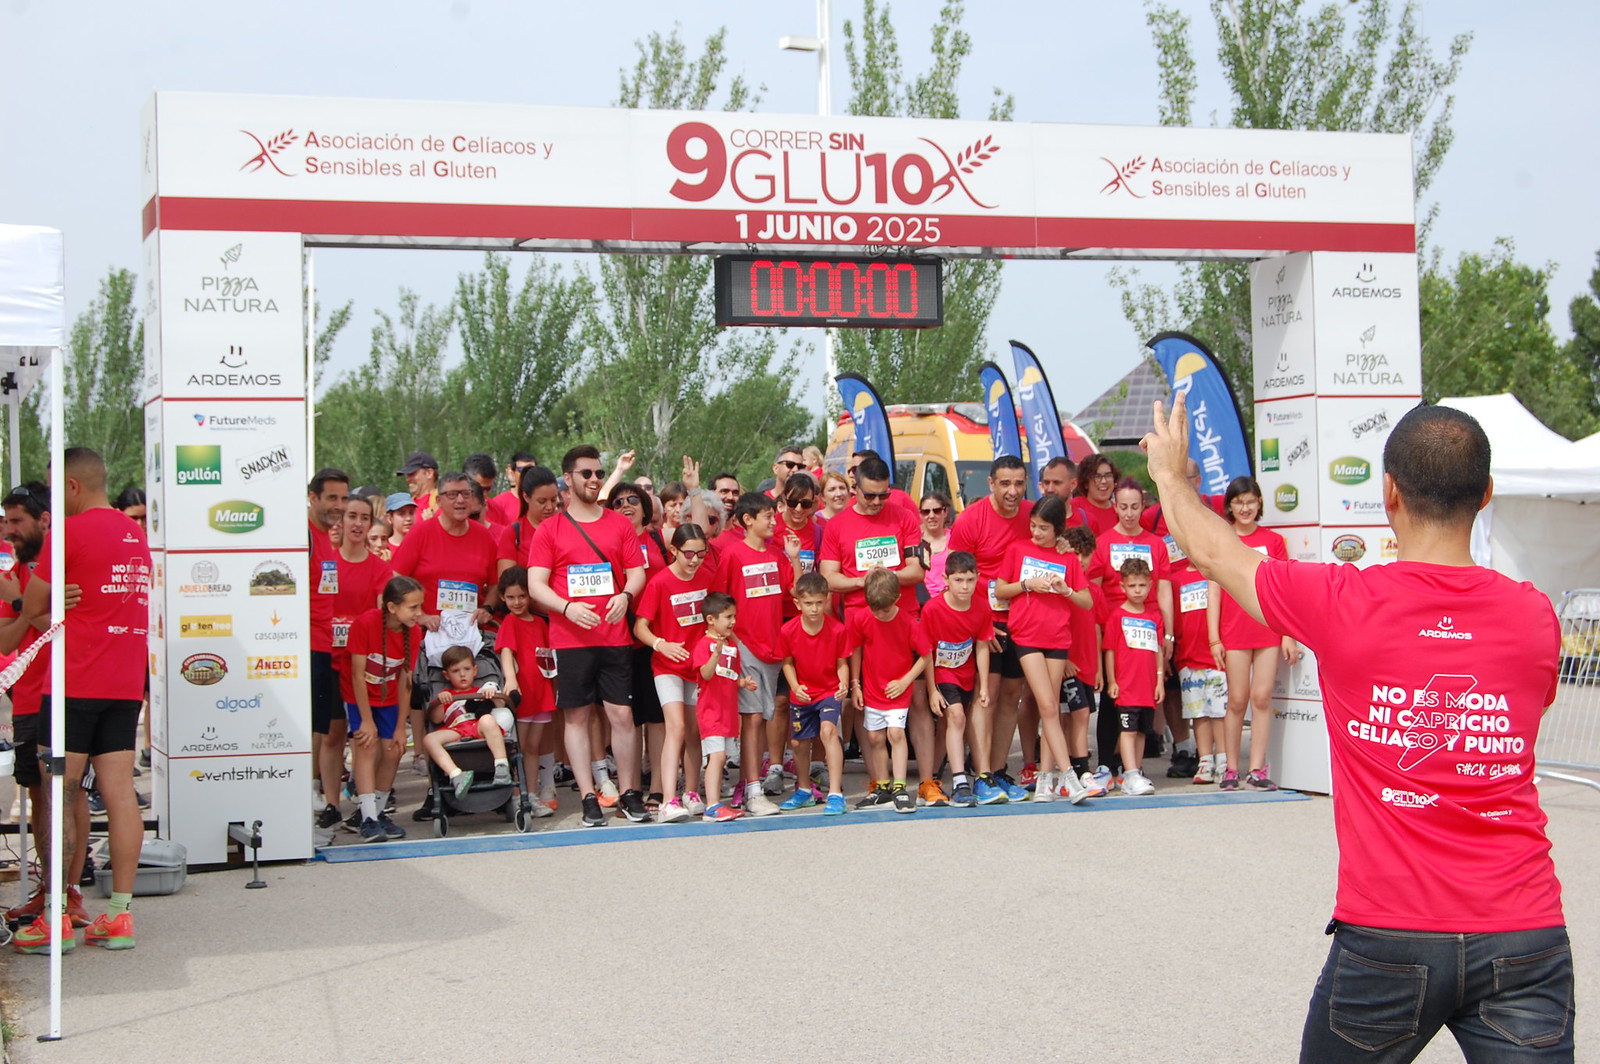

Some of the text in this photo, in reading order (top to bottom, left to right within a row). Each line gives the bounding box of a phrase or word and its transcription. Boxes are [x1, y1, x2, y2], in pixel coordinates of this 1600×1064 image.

[304, 131, 554, 160] Asociación de Celíacos y
[730, 128, 864, 151] CORRER SIN
[305, 157, 497, 180] Sensibles al Gluten
[1151, 157, 1351, 181] Asociación de Celíacos y
[1152, 180, 1307, 199] Sensibles al Gluten
[735, 214, 941, 242] 1 JUNIO 2025
[750, 260, 918, 318] 00:00:00
[1332, 288, 1402, 298] ARDEMOS
[184, 298, 279, 313] NATURA
[1261, 311, 1303, 328] NATURA
[187, 374, 281, 386] ARDEMOS
[1264, 375, 1304, 389] ARDEMOS
[1333, 372, 1404, 385] NATURA
[209, 415, 277, 425] FutureMeds
[178, 467, 220, 483] gullón
[1354, 501, 1383, 510] Future
[215, 507, 260, 522] Maná
[866, 547, 889, 560] 5209
[579, 575, 602, 586] 3108
[179, 584, 232, 593] ABUELOBREAD
[448, 591, 469, 602] 3111
[254, 631, 298, 642] cascajares
[1132, 628, 1152, 640] 3119
[1419, 629, 1472, 640] ARDEMOS
[216, 693, 264, 712] algadi
[1372, 685, 1509, 711] NO ES MODA
[1369, 705, 1510, 733] NI CAPRICHO
[1347, 720, 1525, 754] CELIACO Y PUNTO
[181, 743, 239, 752] ARDEMOS
[251, 741, 293, 749] NATURA
[196, 766, 293, 782] eventsthinker
[1456, 763, 1485, 776] F#CK
